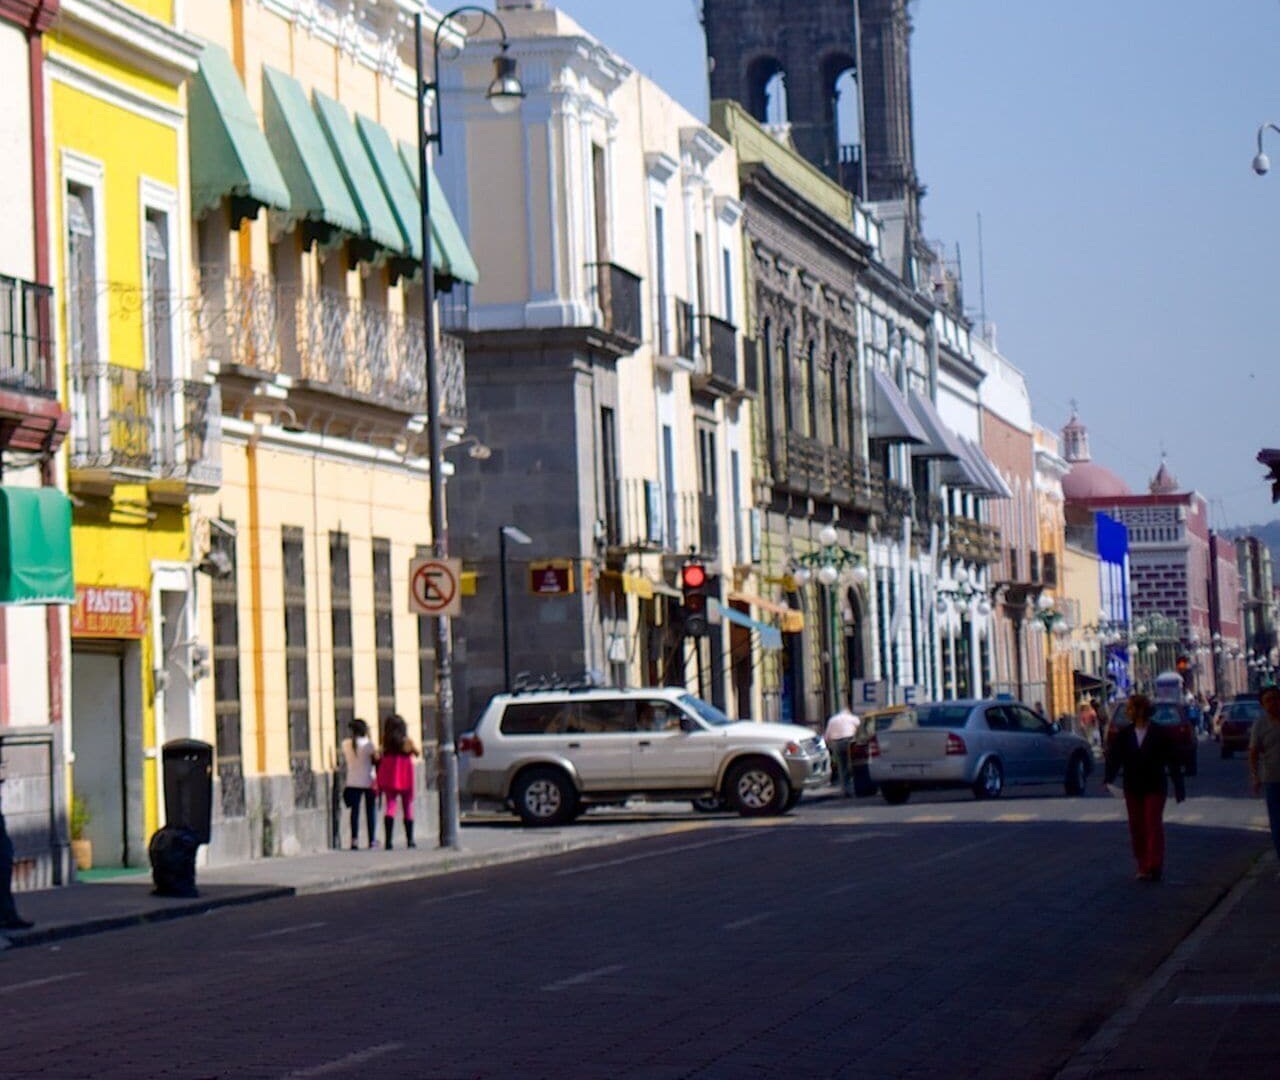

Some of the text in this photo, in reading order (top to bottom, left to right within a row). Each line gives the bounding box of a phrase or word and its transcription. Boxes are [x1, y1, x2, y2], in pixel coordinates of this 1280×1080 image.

[424, 572, 442, 600] E
[86, 588, 134, 613] PASTES
[863, 682, 877, 703] E
[904, 686, 916, 708] E
